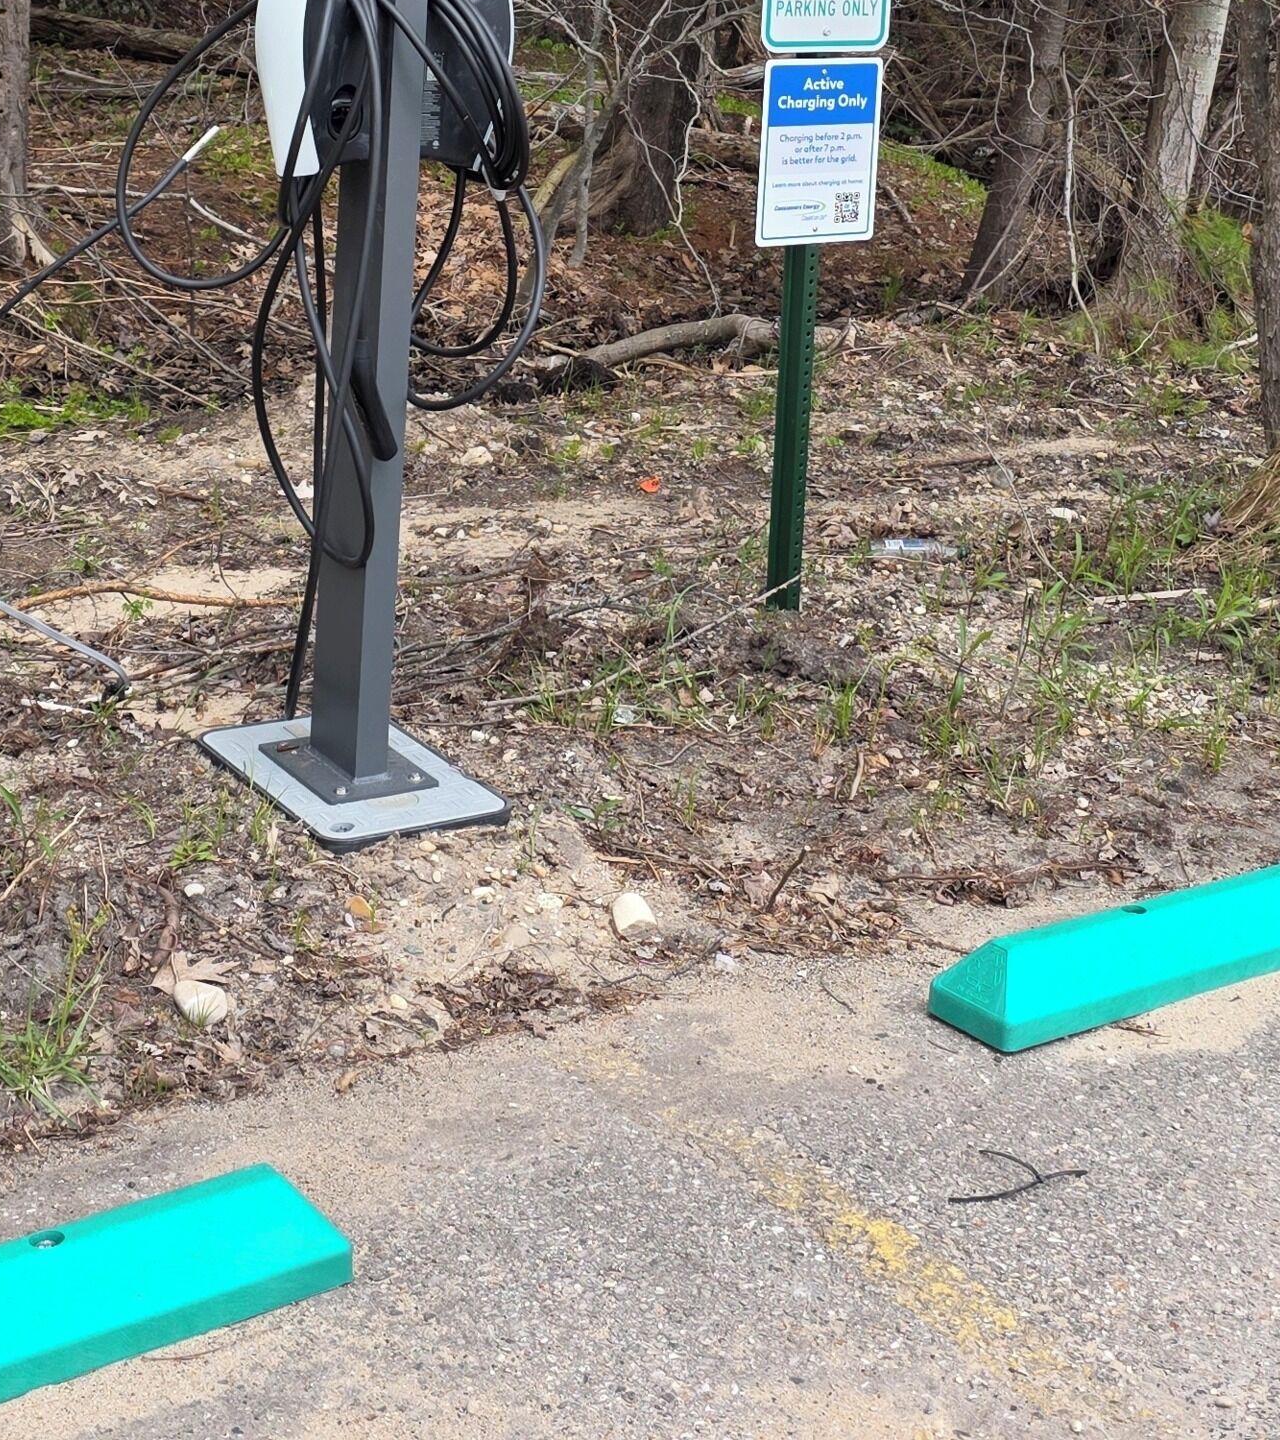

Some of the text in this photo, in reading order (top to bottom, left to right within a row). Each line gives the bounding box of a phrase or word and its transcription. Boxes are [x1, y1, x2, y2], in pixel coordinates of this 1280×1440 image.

[776, 0, 878, 17] PARKING ONLY
[803, 77, 845, 90] Active
[777, 94, 868, 111] Charging Only
[779, 134, 813, 144] Charging
[815, 132, 839, 141] before
[840, 132, 845, 140] 2
[803, 144, 823, 153] after
[823, 144, 829, 152] 7
[789, 157, 813, 165] better
[815, 156, 825, 164] for
[827, 155, 839, 163] the
